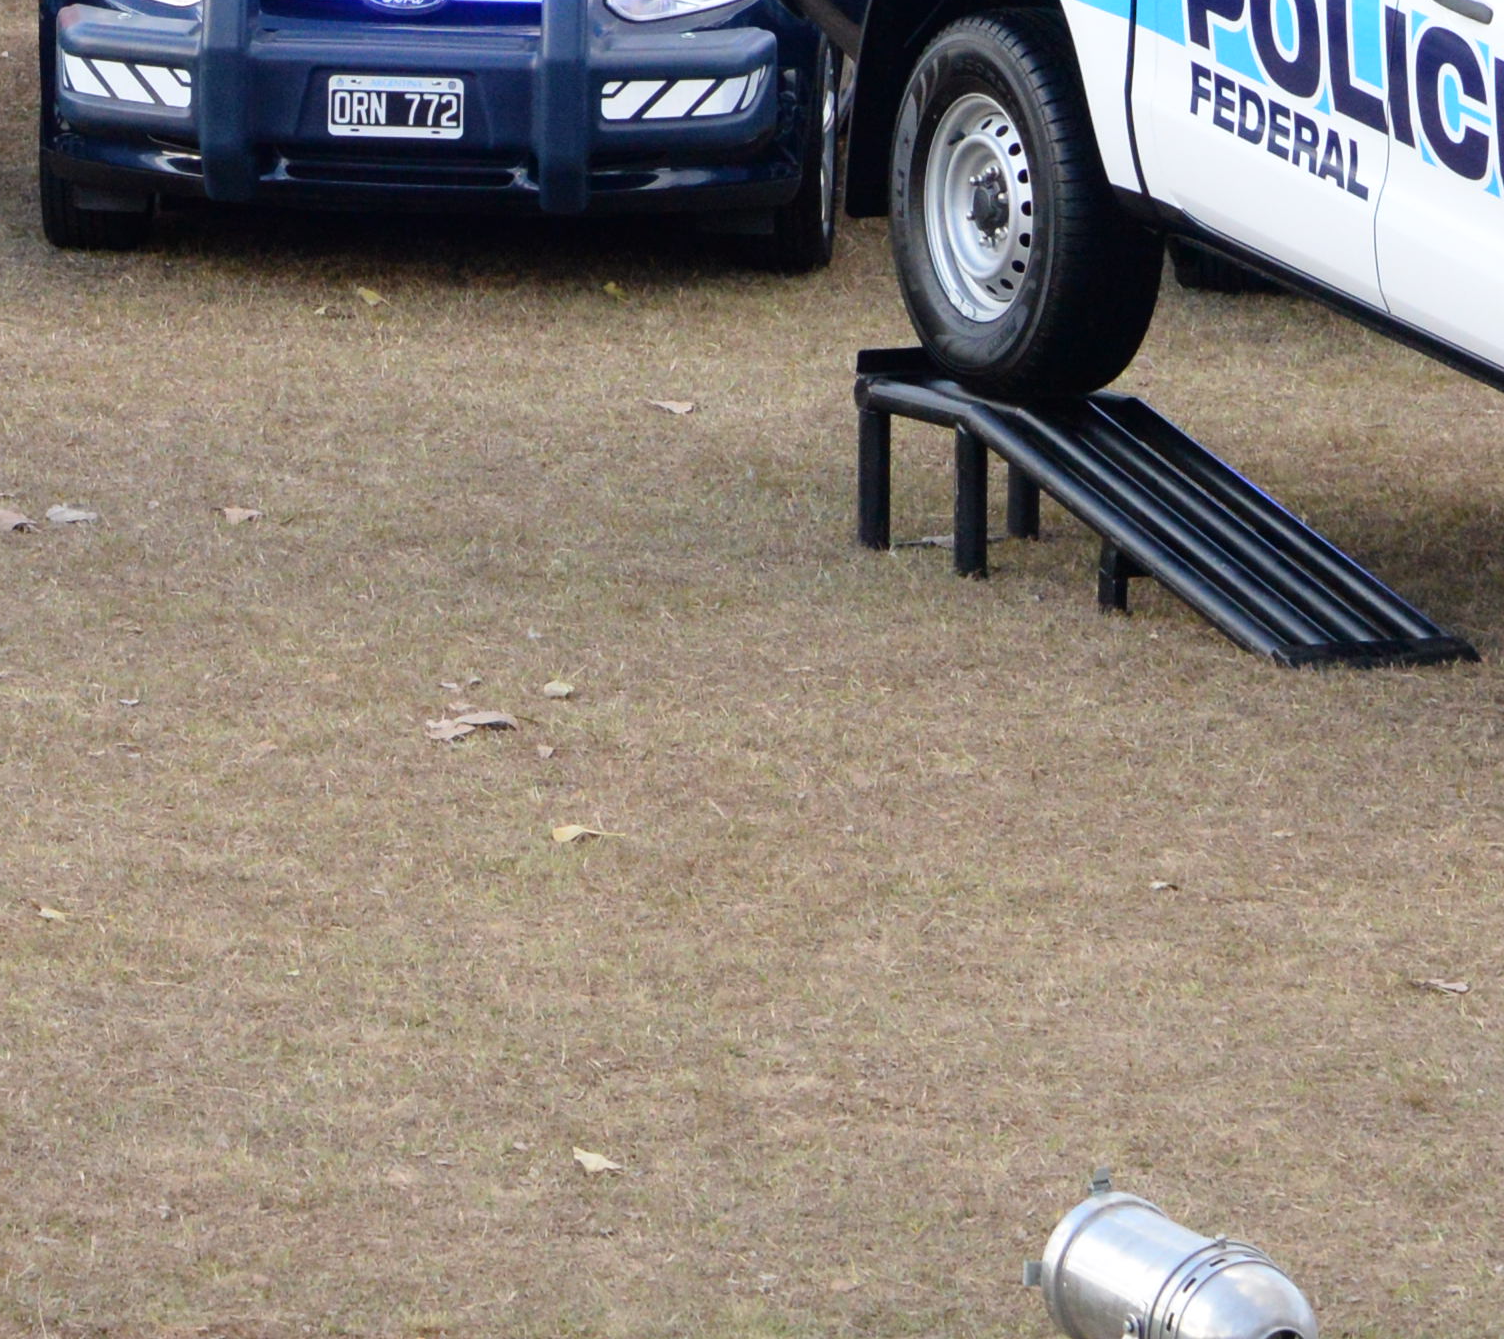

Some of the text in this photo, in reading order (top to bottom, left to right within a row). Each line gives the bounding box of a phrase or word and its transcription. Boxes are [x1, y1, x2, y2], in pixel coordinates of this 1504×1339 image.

[334, 91, 458, 127] ORN 772
[1190, 61, 1370, 202] FEDERAL
